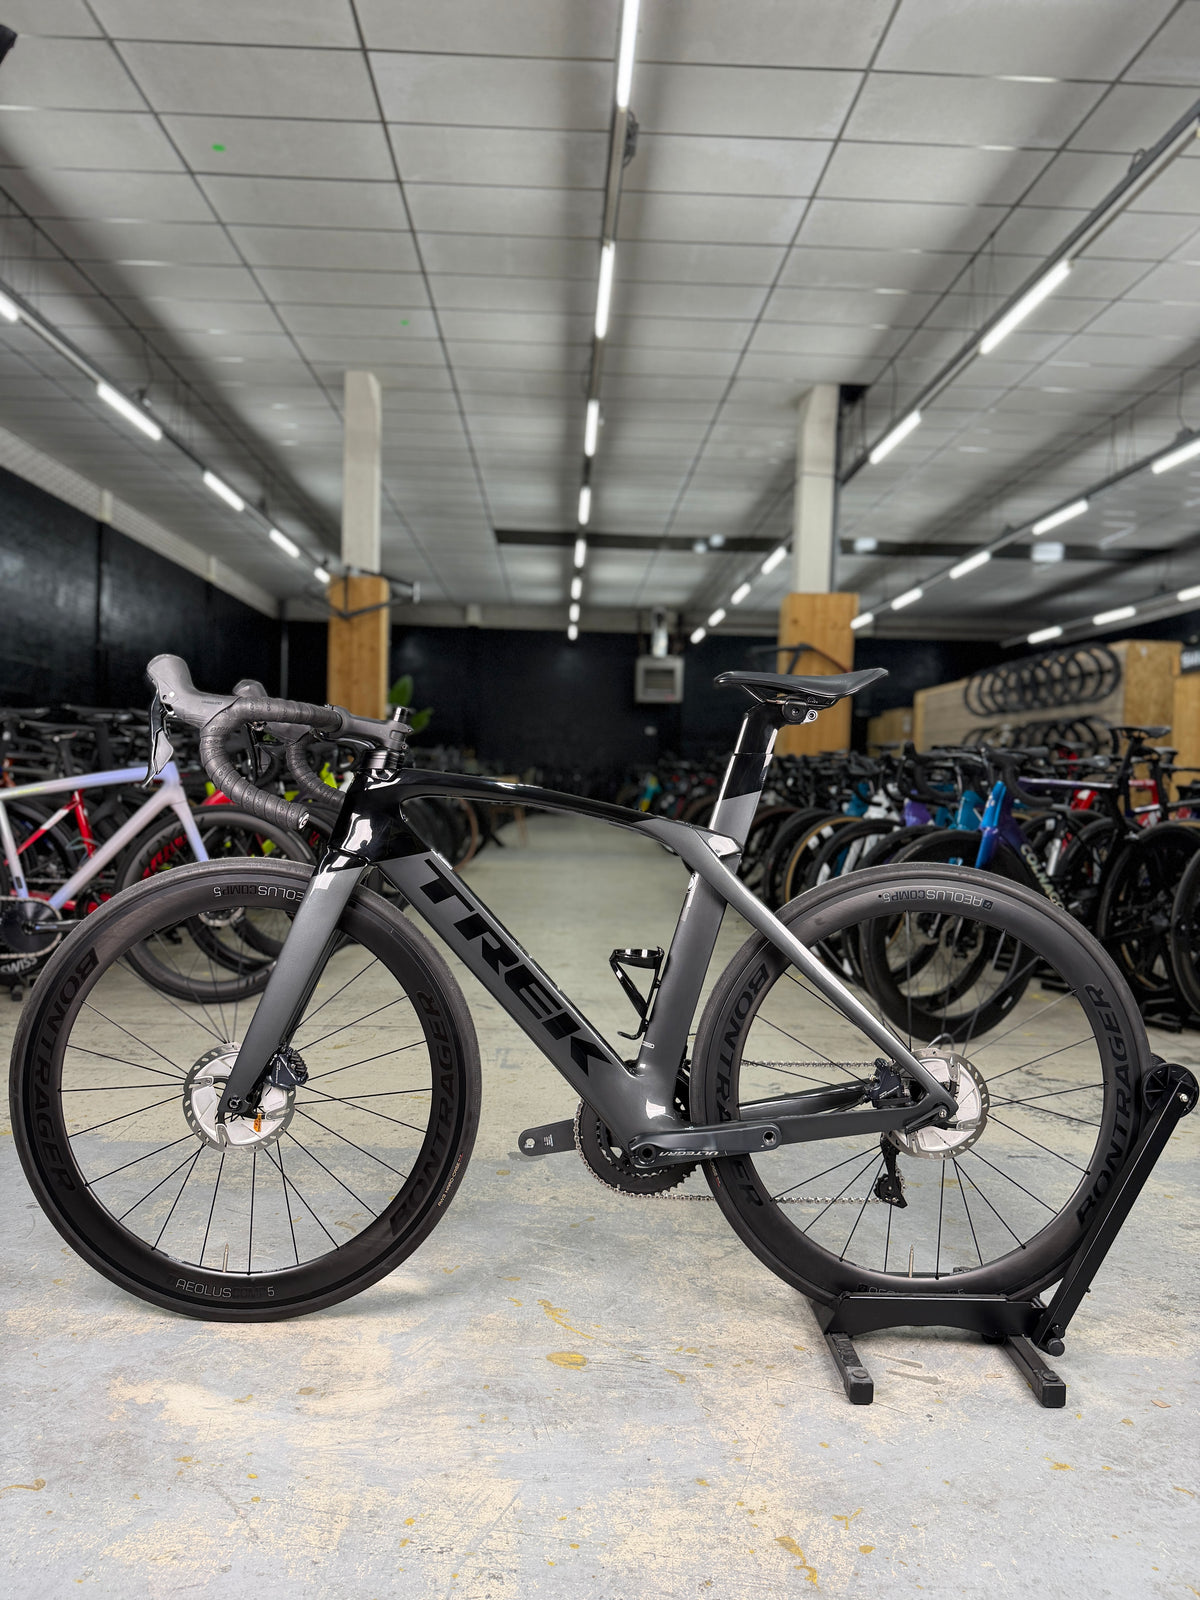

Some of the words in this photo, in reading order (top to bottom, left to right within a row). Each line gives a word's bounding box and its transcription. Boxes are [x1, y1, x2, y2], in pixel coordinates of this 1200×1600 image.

[29, 947, 99, 1192] BONTRAGER
[419, 858, 613, 1077] TREK
[389, 989, 458, 1237] BONTRAGER
[175, 1278, 232, 1298] AEOLUS
